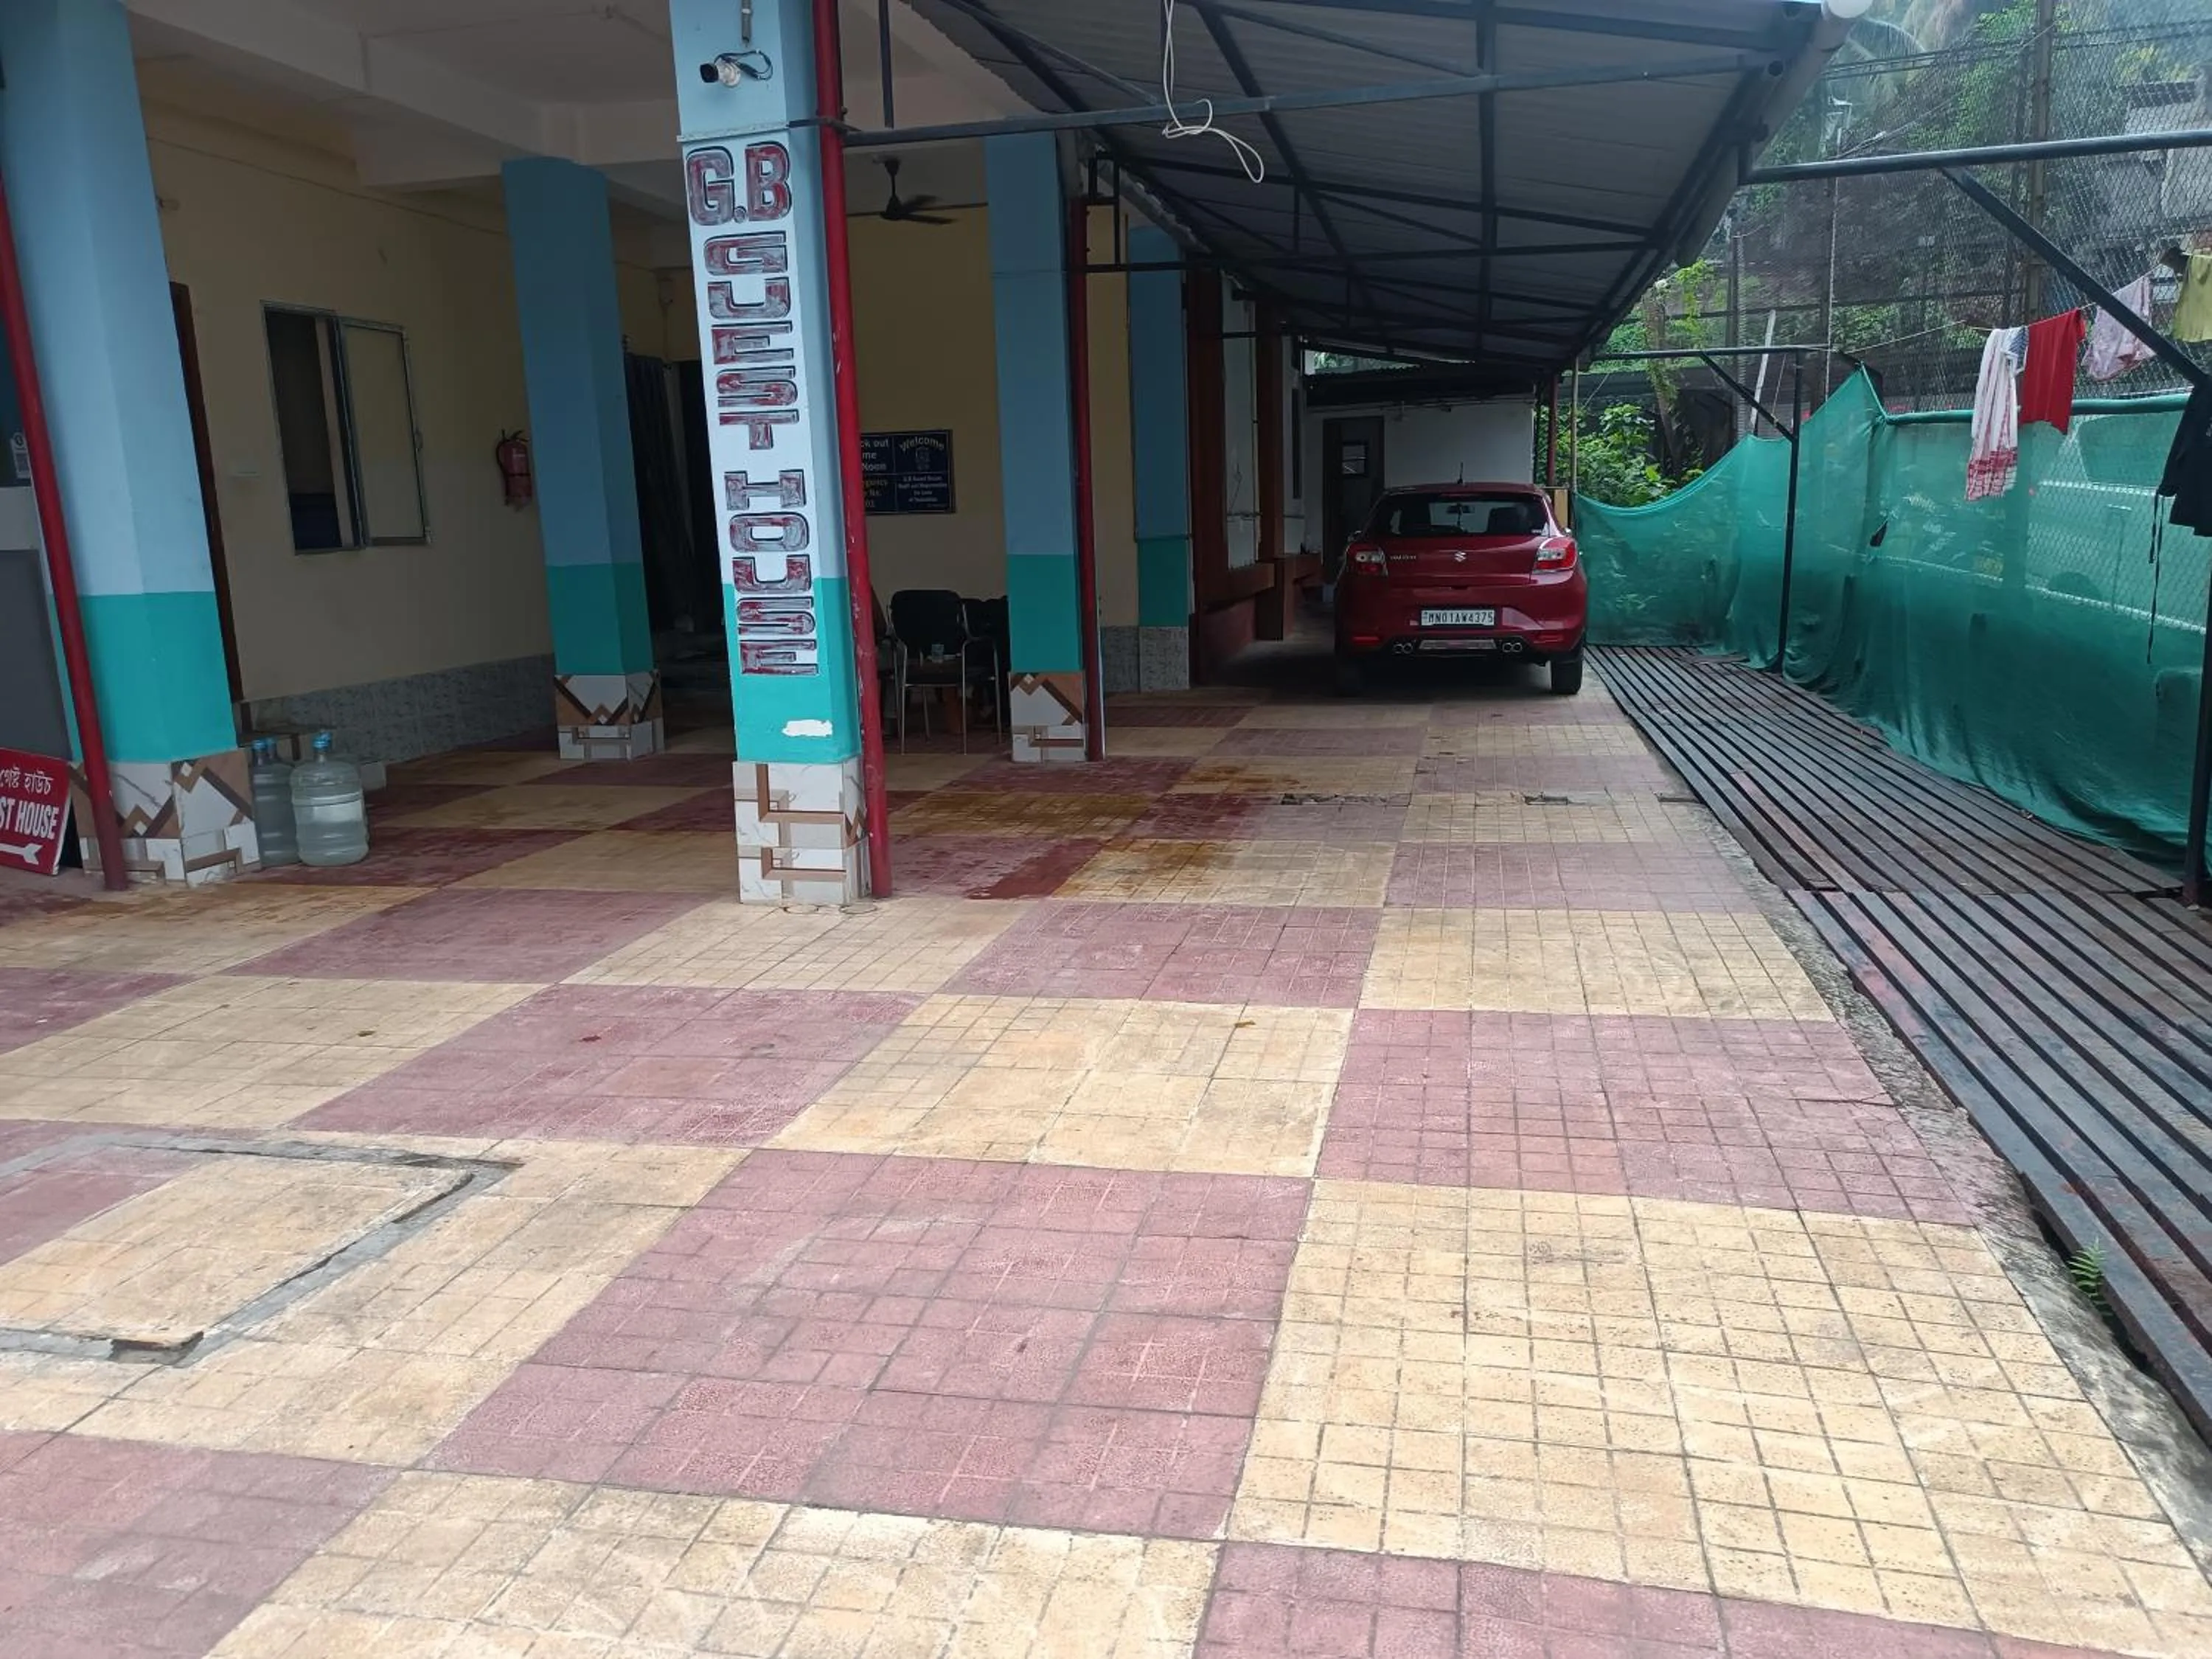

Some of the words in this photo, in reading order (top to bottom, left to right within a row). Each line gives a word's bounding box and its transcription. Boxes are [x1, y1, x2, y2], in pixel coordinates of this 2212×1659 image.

[686, 141, 793, 226] G.B
[704, 230, 801, 450] GUEST
[724, 469, 819, 675] HOUSE
[14, 800, 60, 840] HOUSE
